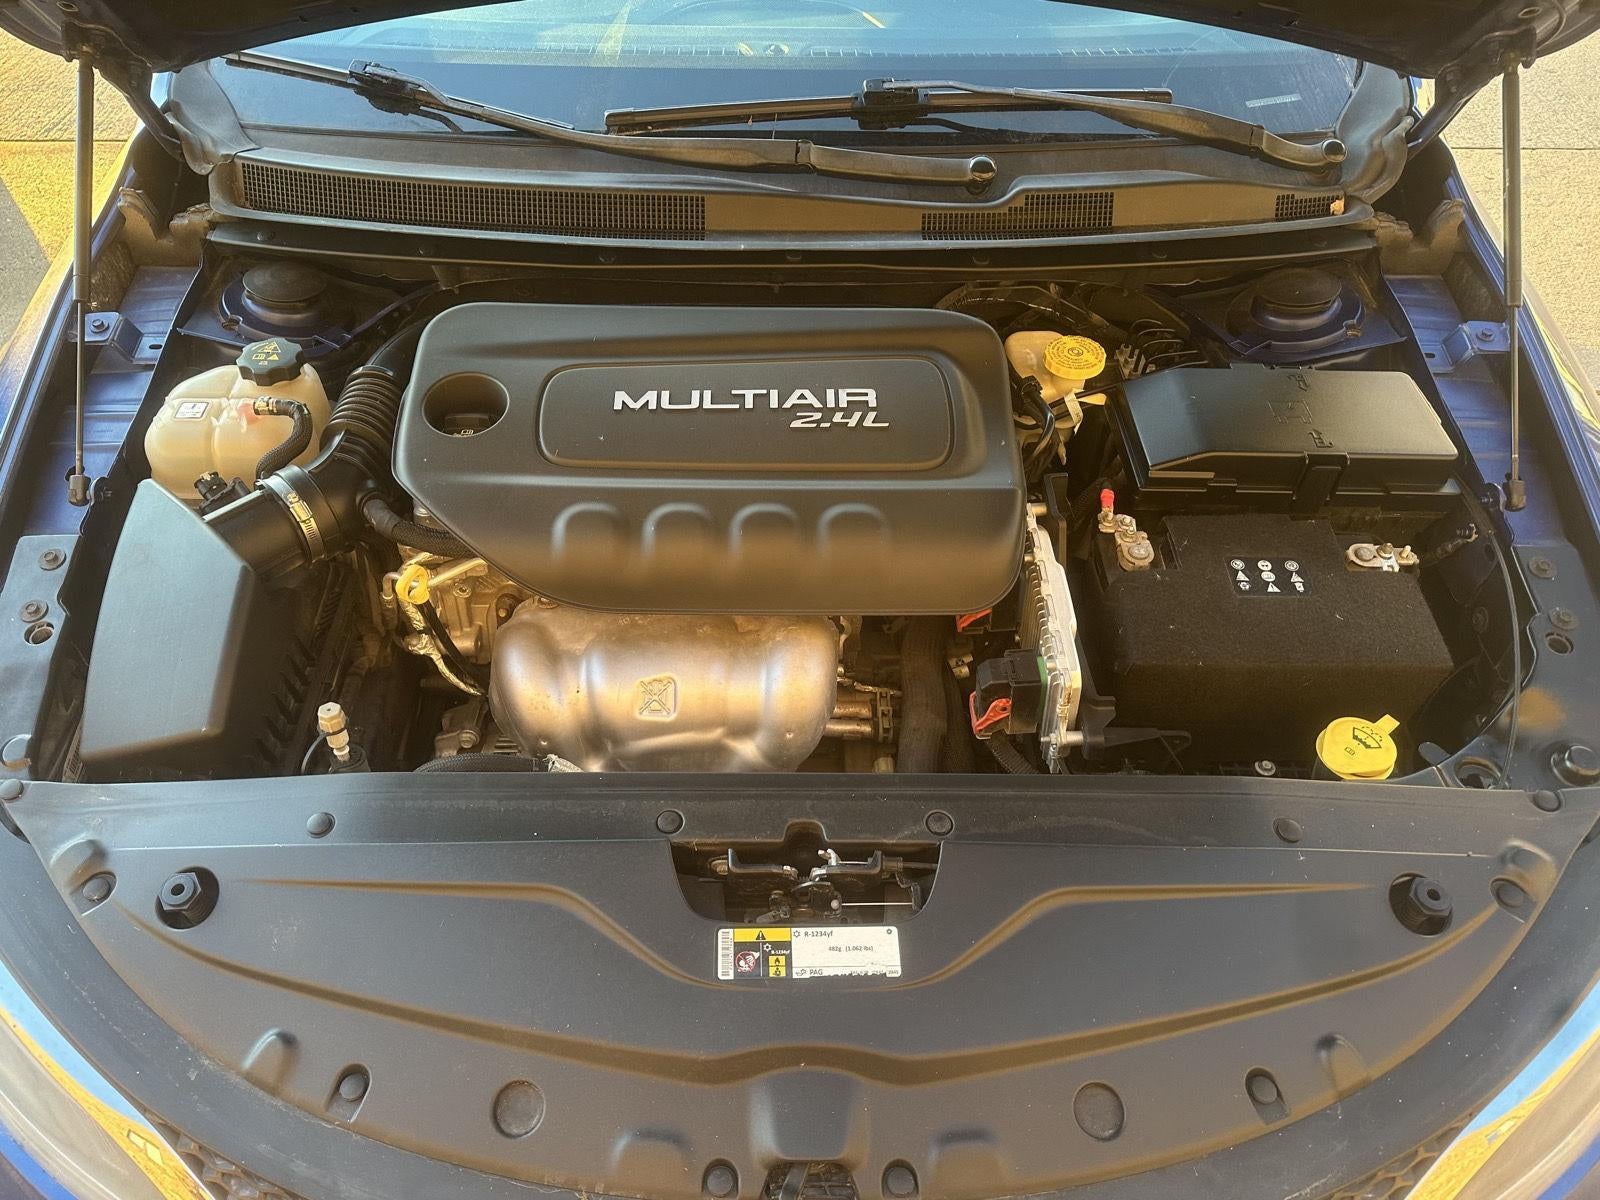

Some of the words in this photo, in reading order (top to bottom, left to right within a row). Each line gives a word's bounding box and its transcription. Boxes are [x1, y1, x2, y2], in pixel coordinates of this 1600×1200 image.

[613, 388, 877, 410] MULTIAIR
[789, 411, 890, 428] 2.4L
[804, 930, 833, 938] R-1234yf
